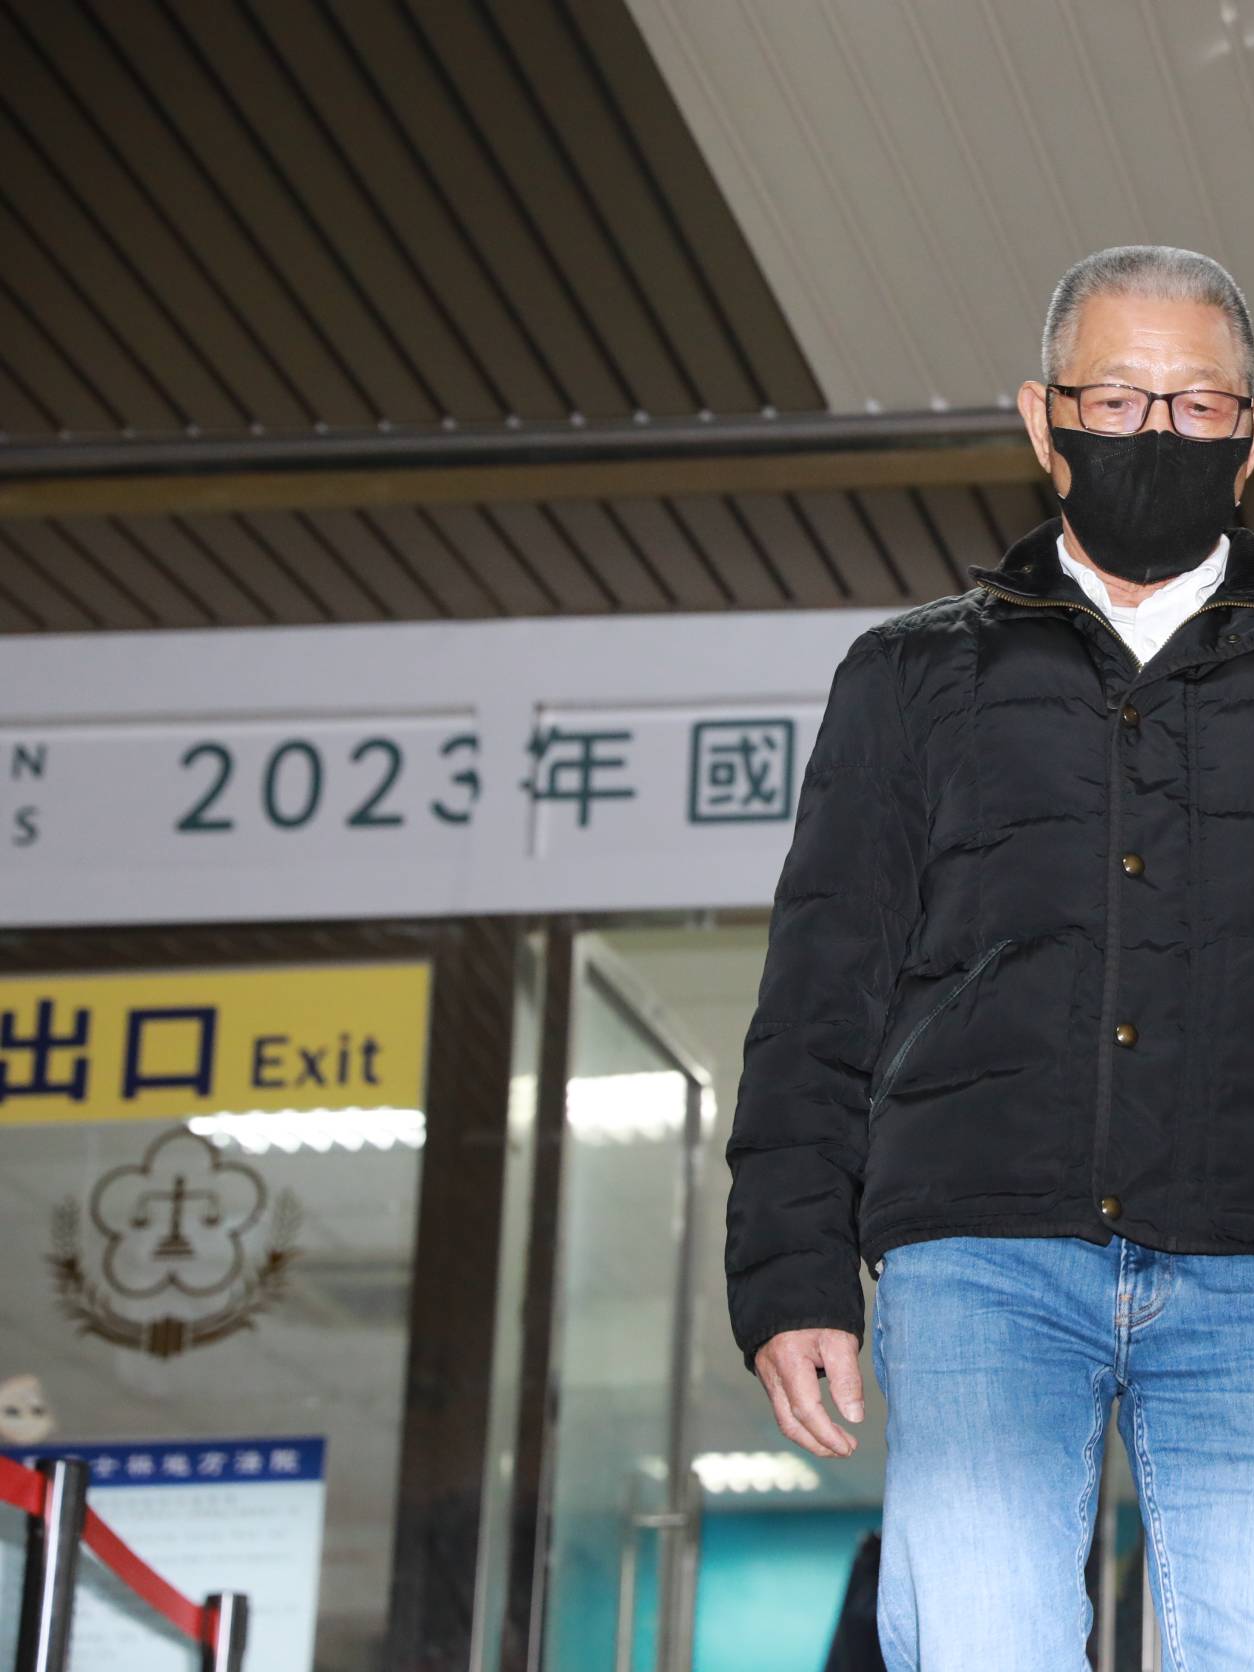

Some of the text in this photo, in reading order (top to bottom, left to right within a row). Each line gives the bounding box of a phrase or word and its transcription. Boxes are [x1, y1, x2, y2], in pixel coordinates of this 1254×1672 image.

[12, 744, 47, 780] N
[12, 806, 39, 847] S
[0, 998, 380, 1104] 出口 Exit
